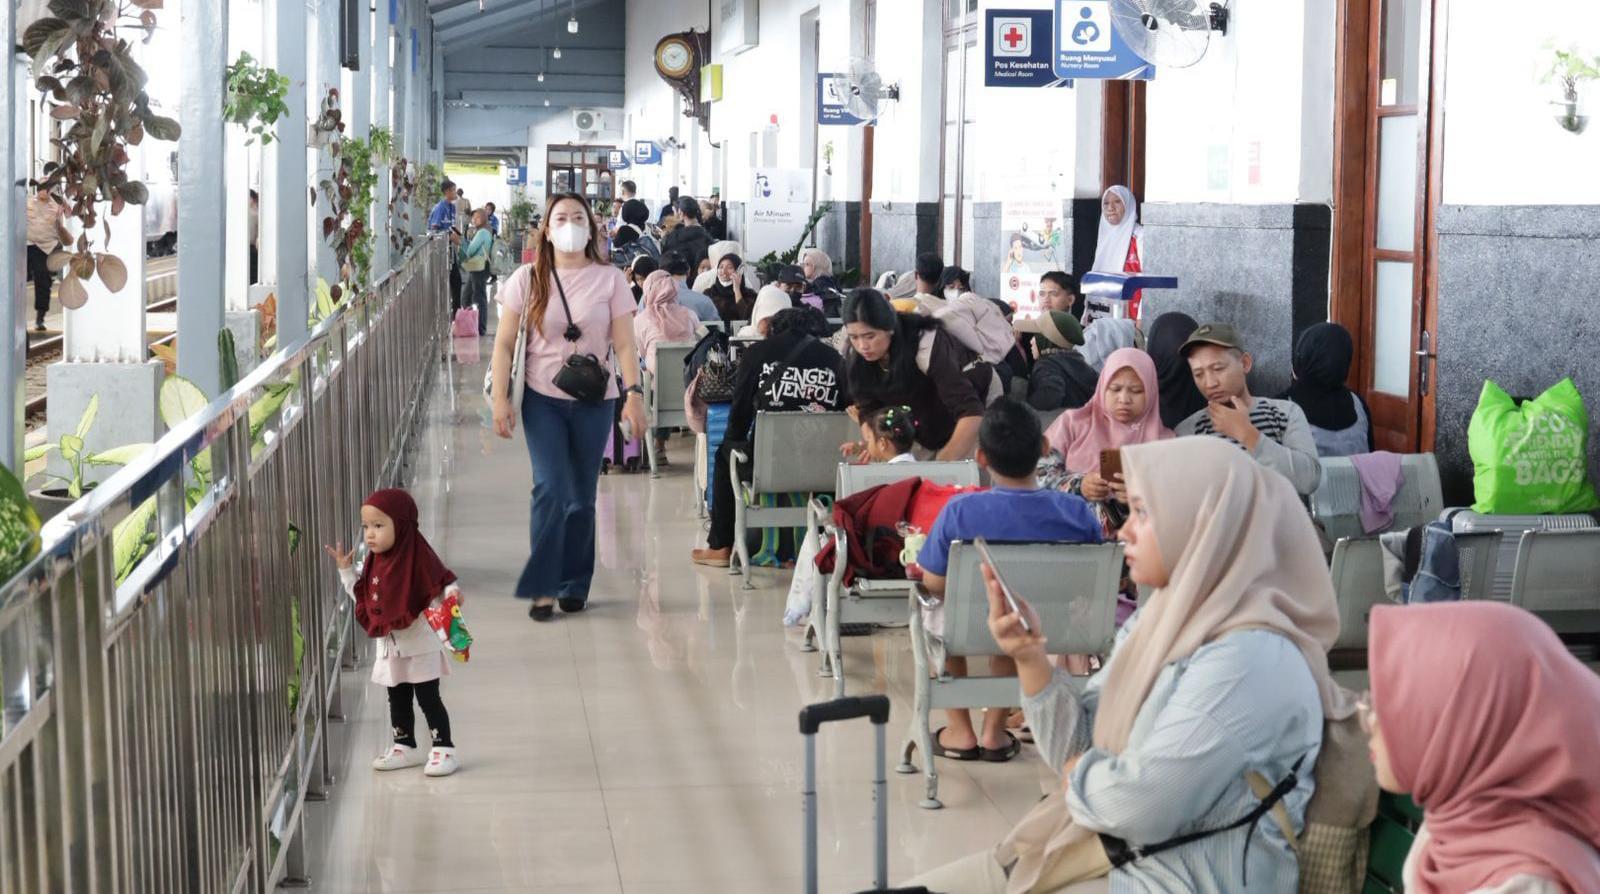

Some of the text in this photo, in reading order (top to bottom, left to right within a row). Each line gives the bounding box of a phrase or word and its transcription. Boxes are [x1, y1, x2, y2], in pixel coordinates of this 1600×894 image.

[994, 61, 1049, 69] Pos Kesehatan
[1060, 54, 1082, 63] Ruang
[761, 361, 836, 386] AENGED
[1515, 458, 1584, 485] BAGS
